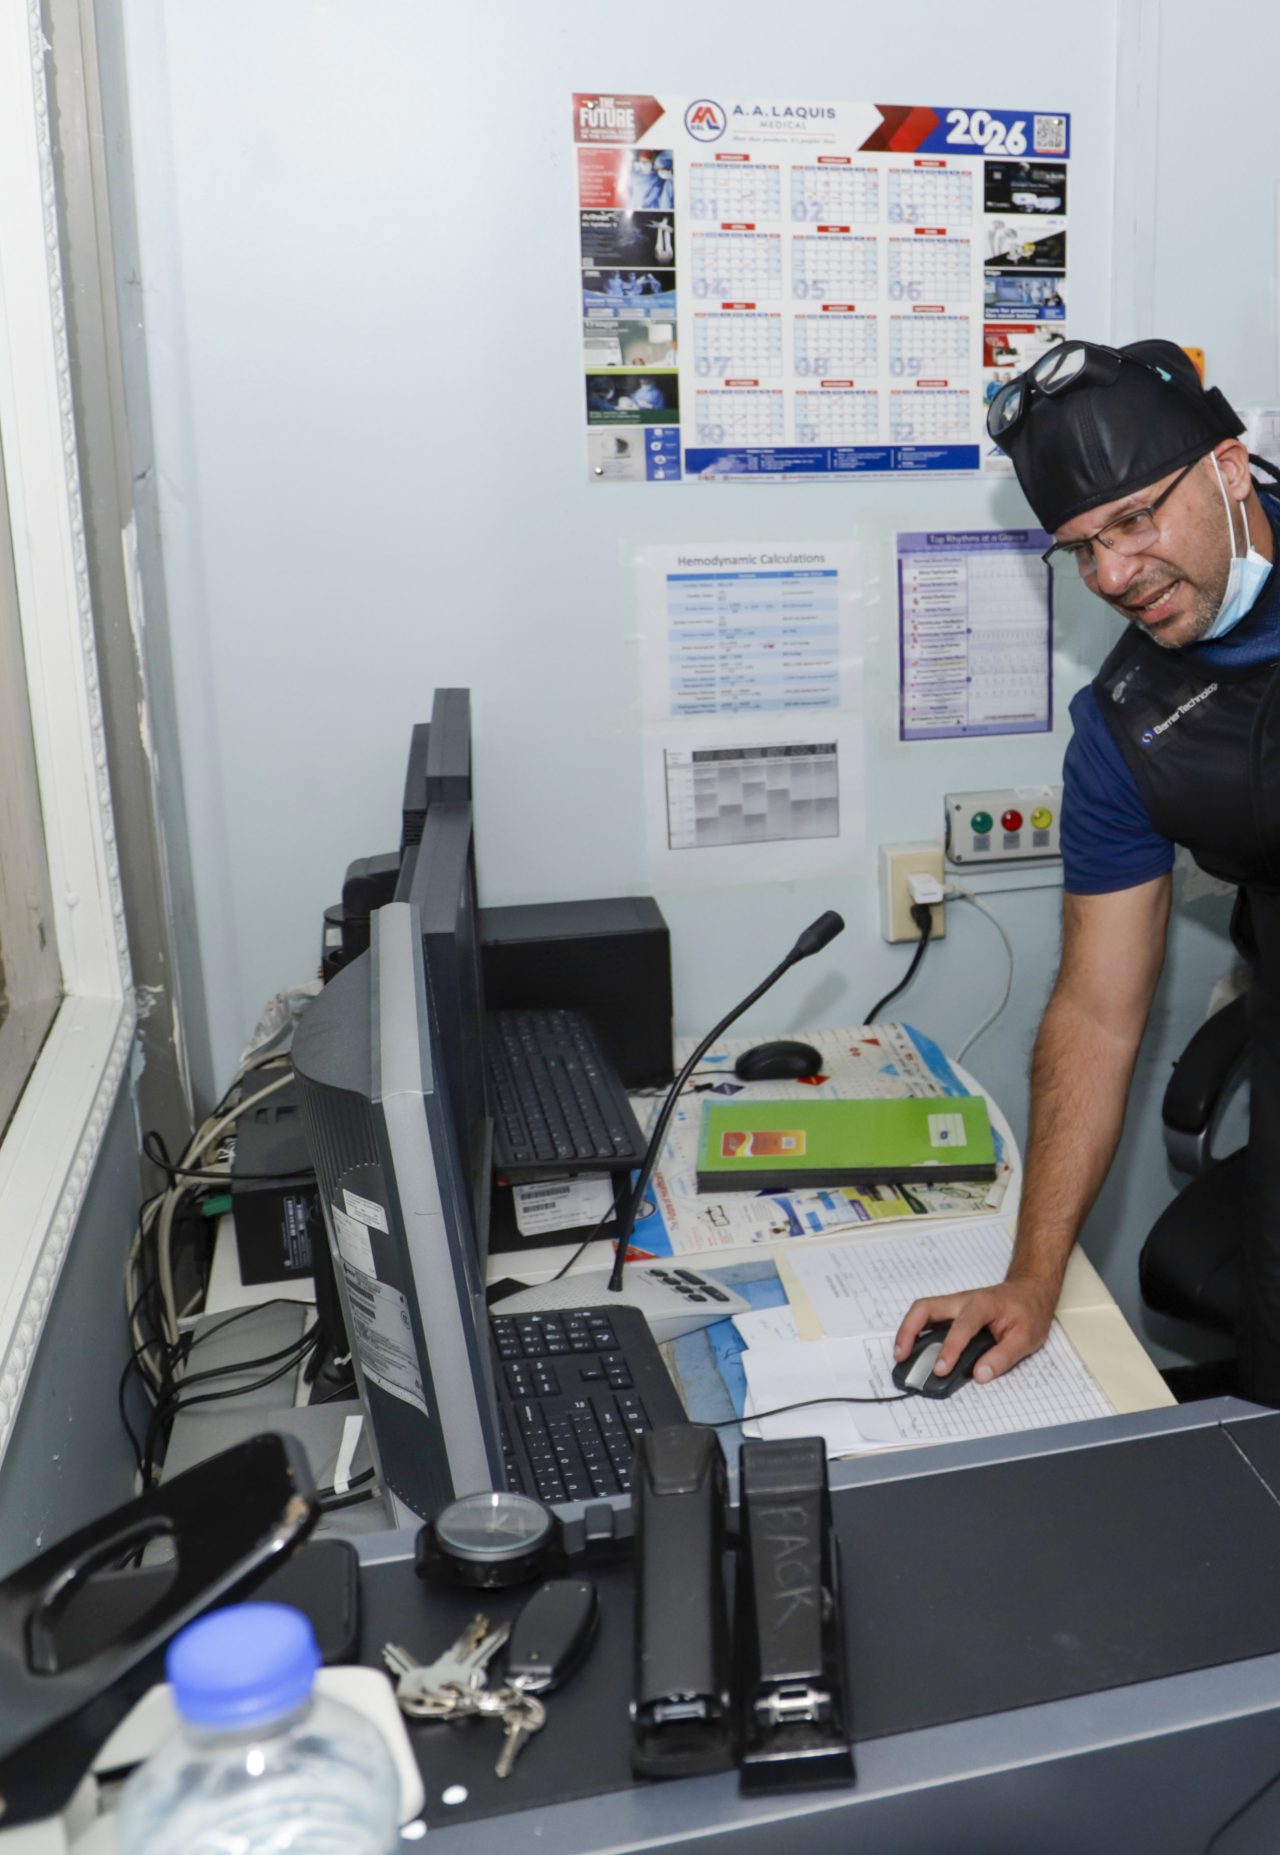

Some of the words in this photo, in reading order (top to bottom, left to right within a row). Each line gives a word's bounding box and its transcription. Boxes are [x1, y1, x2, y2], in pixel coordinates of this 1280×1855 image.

[579, 107, 635, 128] FUTURE
[760, 121, 807, 130] MEDICAL
[946, 109, 1027, 156] 2026
[677, 554, 758, 568] Hemodynamic
[760, 553, 825, 565] Calculations
[757, 1506, 817, 1631] BACK
